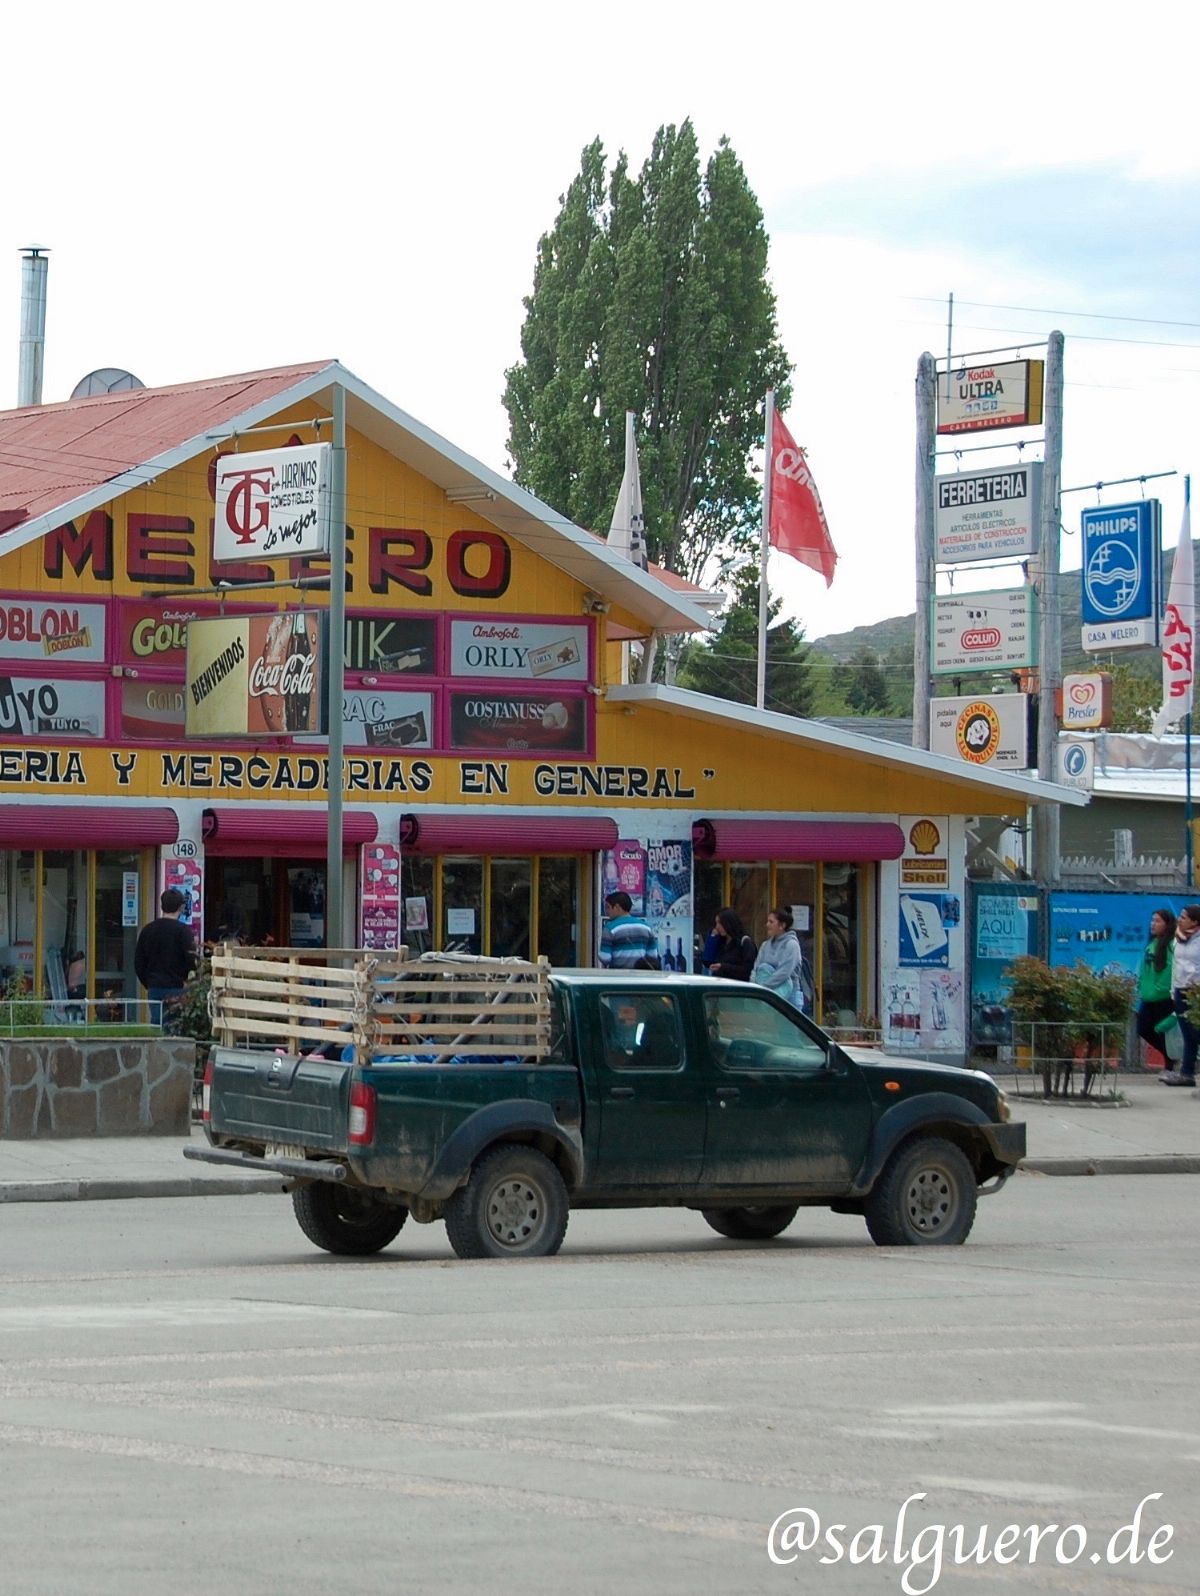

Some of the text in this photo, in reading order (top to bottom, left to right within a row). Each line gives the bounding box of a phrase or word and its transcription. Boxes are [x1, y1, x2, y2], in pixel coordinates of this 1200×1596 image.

[967, 368, 995, 381] Kodak
[960, 379, 1004, 400] ULTRA
[950, 422, 972, 431] CASA
[281, 460, 317, 490] HARINAS
[270, 490, 314, 509] COMESTIBLES
[940, 473, 1025, 507] FERRETERIA
[263, 509, 318, 551] Lo mejor
[1087, 516, 1137, 539] PHILIPS
[472, 625, 521, 641] Ambrosoli
[1087, 626, 1139, 643] CASA MELERO
[51, 635, 85, 653] DOBLON
[465, 645, 530, 668] ORLY
[532, 653, 552, 665] ORLY
[190, 636, 246, 706] BIENVENIDOS
[343, 696, 385, 723] AC
[464, 700, 545, 720] COSTANUSS
[958, 704, 993, 731] CECINAS
[50, 717, 82, 731] TUYO
[372, 721, 395, 736] FRAC
[111, 752, 138, 785] Y
[459, 761, 510, 795] EN
[176, 843, 194, 856] 148
[648, 844, 682, 862] AMOR
[903, 872, 946, 883] Shell
